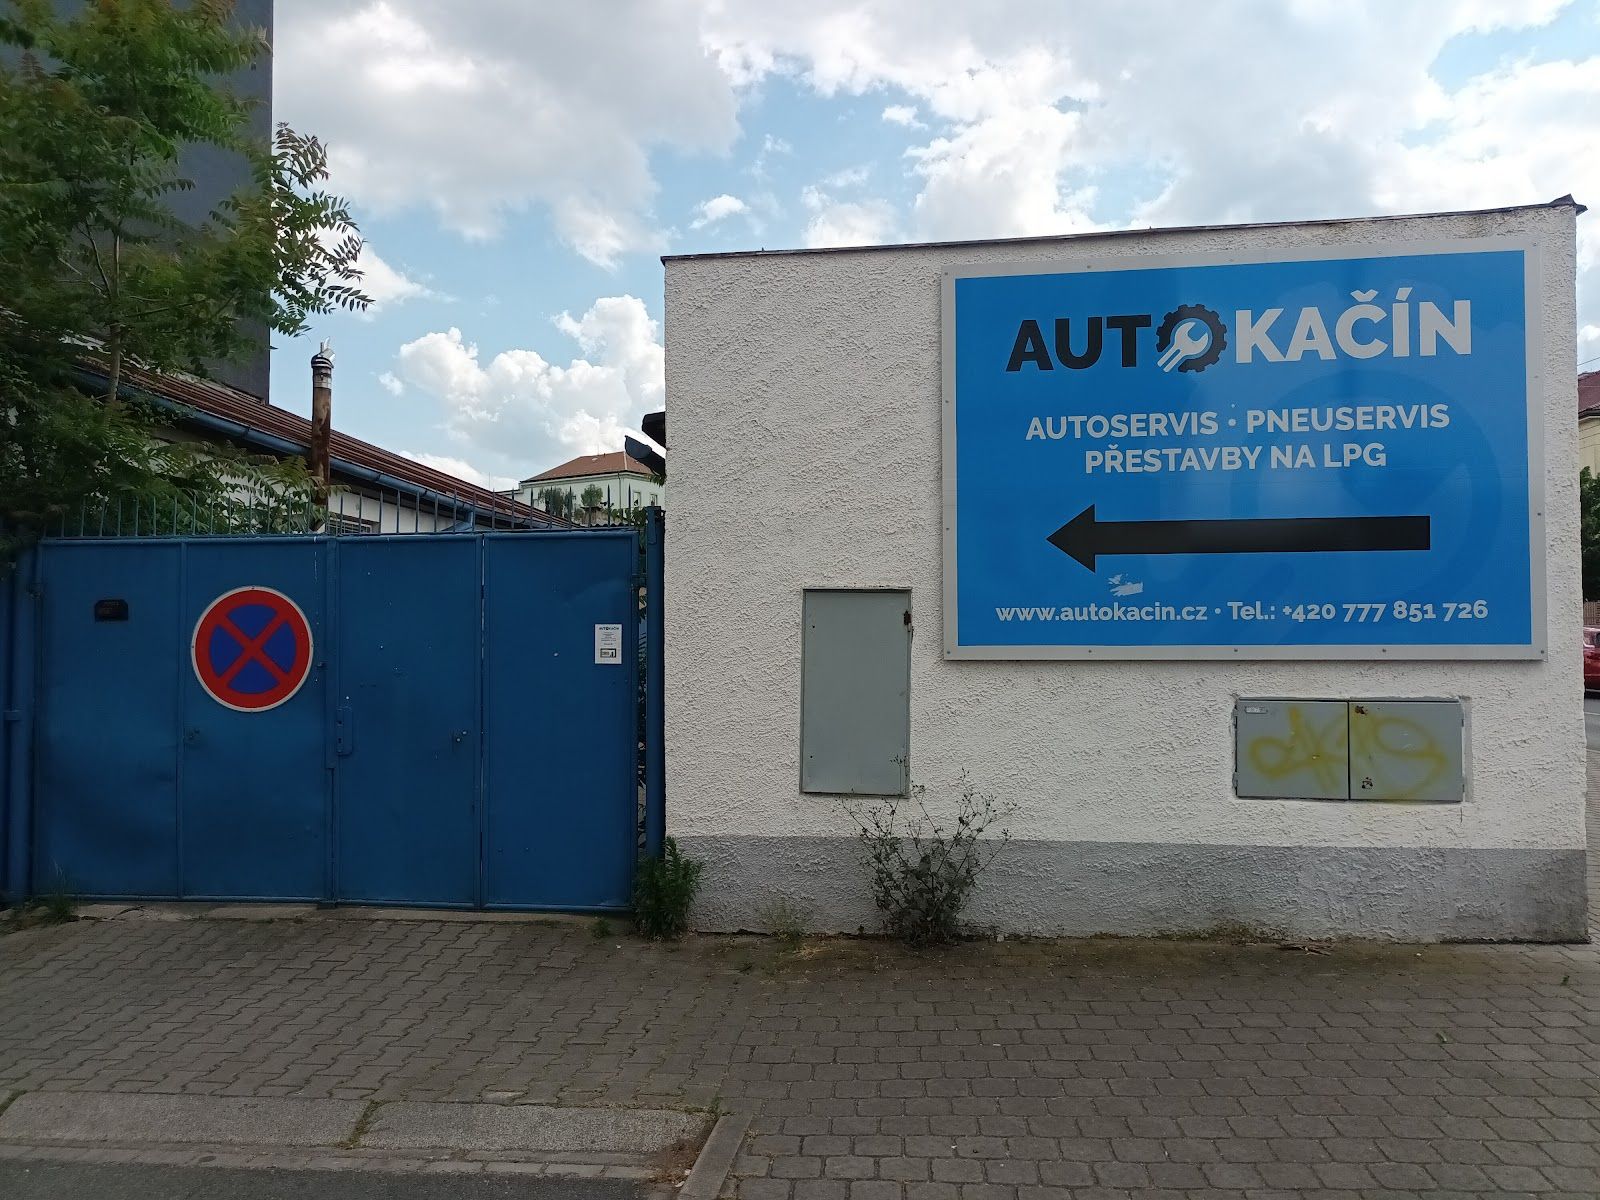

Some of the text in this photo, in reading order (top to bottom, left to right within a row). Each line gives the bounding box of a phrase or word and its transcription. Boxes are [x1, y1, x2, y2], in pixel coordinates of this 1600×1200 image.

[1025, 403, 1451, 441] AUTOSERVIS PNEUSERVIS
[1085, 442, 1387, 474] PŘESTAVBY NA LPG
[995, 600, 1489, 623] www.autokacin.cz Tel.: +420 777 851 726
